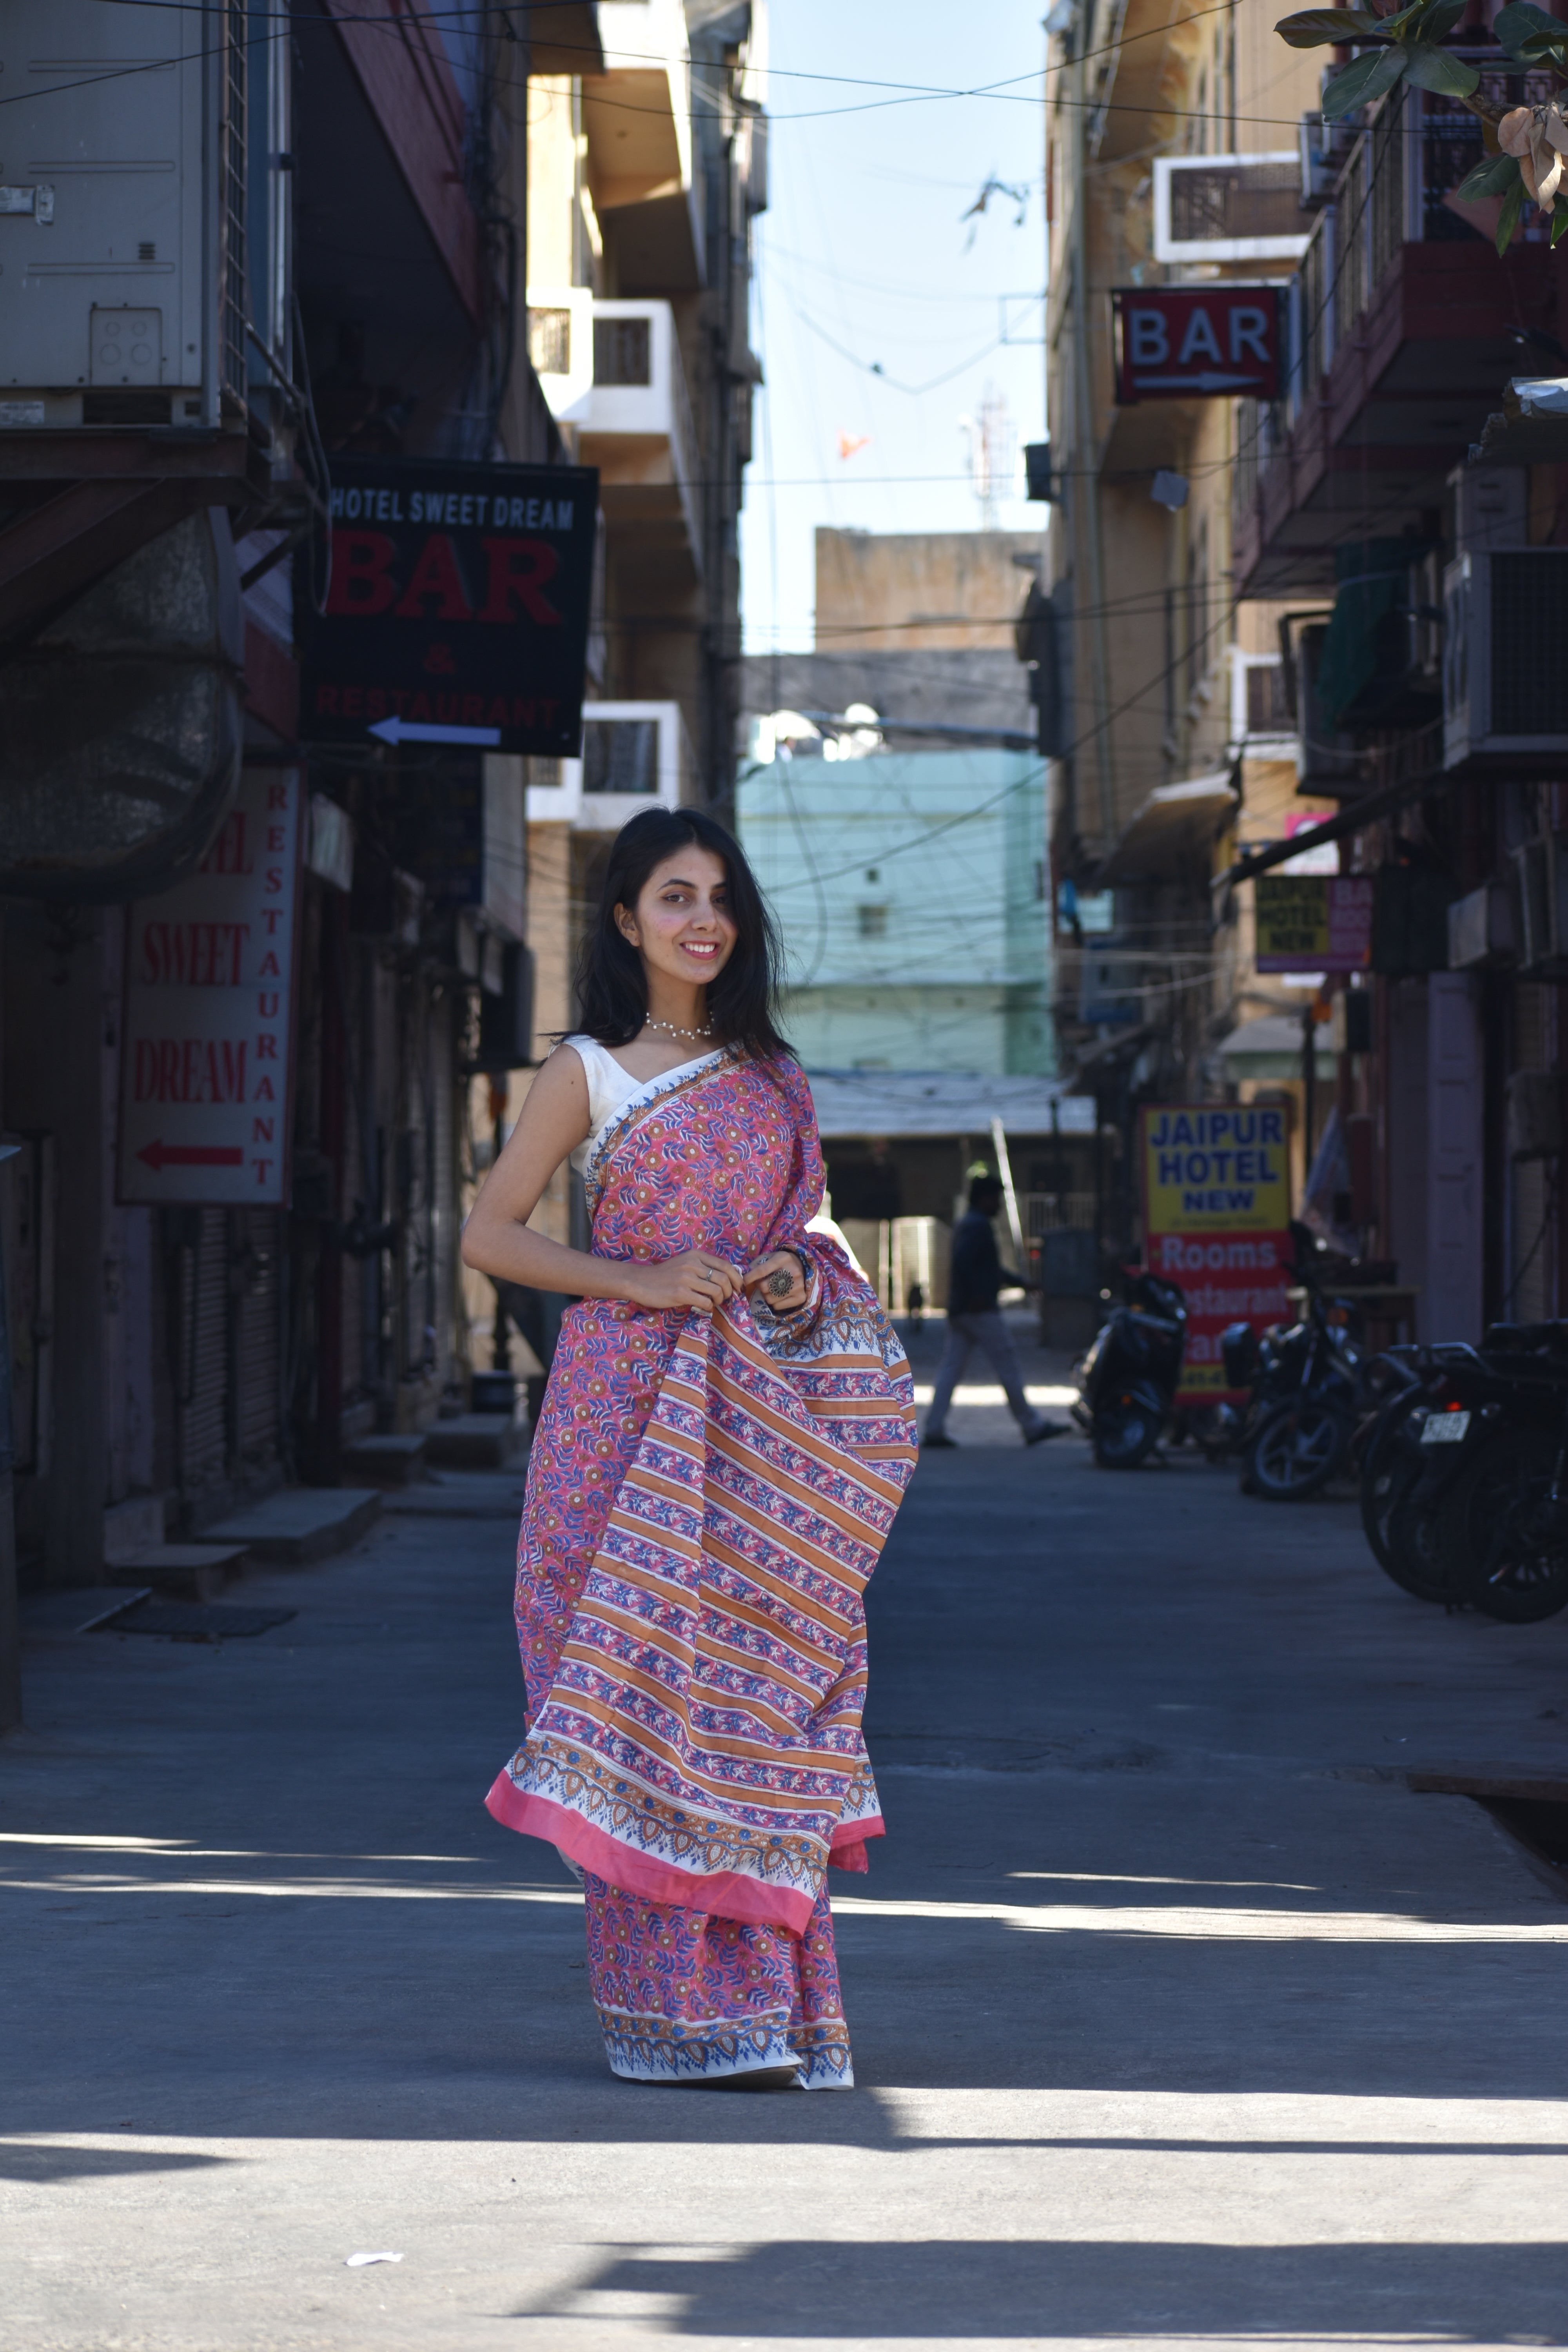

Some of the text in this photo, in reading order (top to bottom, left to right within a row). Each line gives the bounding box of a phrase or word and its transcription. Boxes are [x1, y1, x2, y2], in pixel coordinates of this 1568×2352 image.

[1129, 306, 1271, 366] BAR
[331, 487, 573, 531] HOTEL SWEET DREAM
[322, 528, 563, 626] BAR
[423, 643, 456, 674] &
[317, 684, 560, 730] RESTAURANT
[142, 922, 250, 987] SWEET
[251, 784, 289, 1185] RESTAURANT
[135, 1039, 247, 1103] DREAM
[1151, 1112, 1283, 1146] JAIPUR
[1158, 1149, 1278, 1184] HOTEL
[1183, 1190, 1254, 1212] NEW
[1160, 1236, 1277, 1271] Rooms
